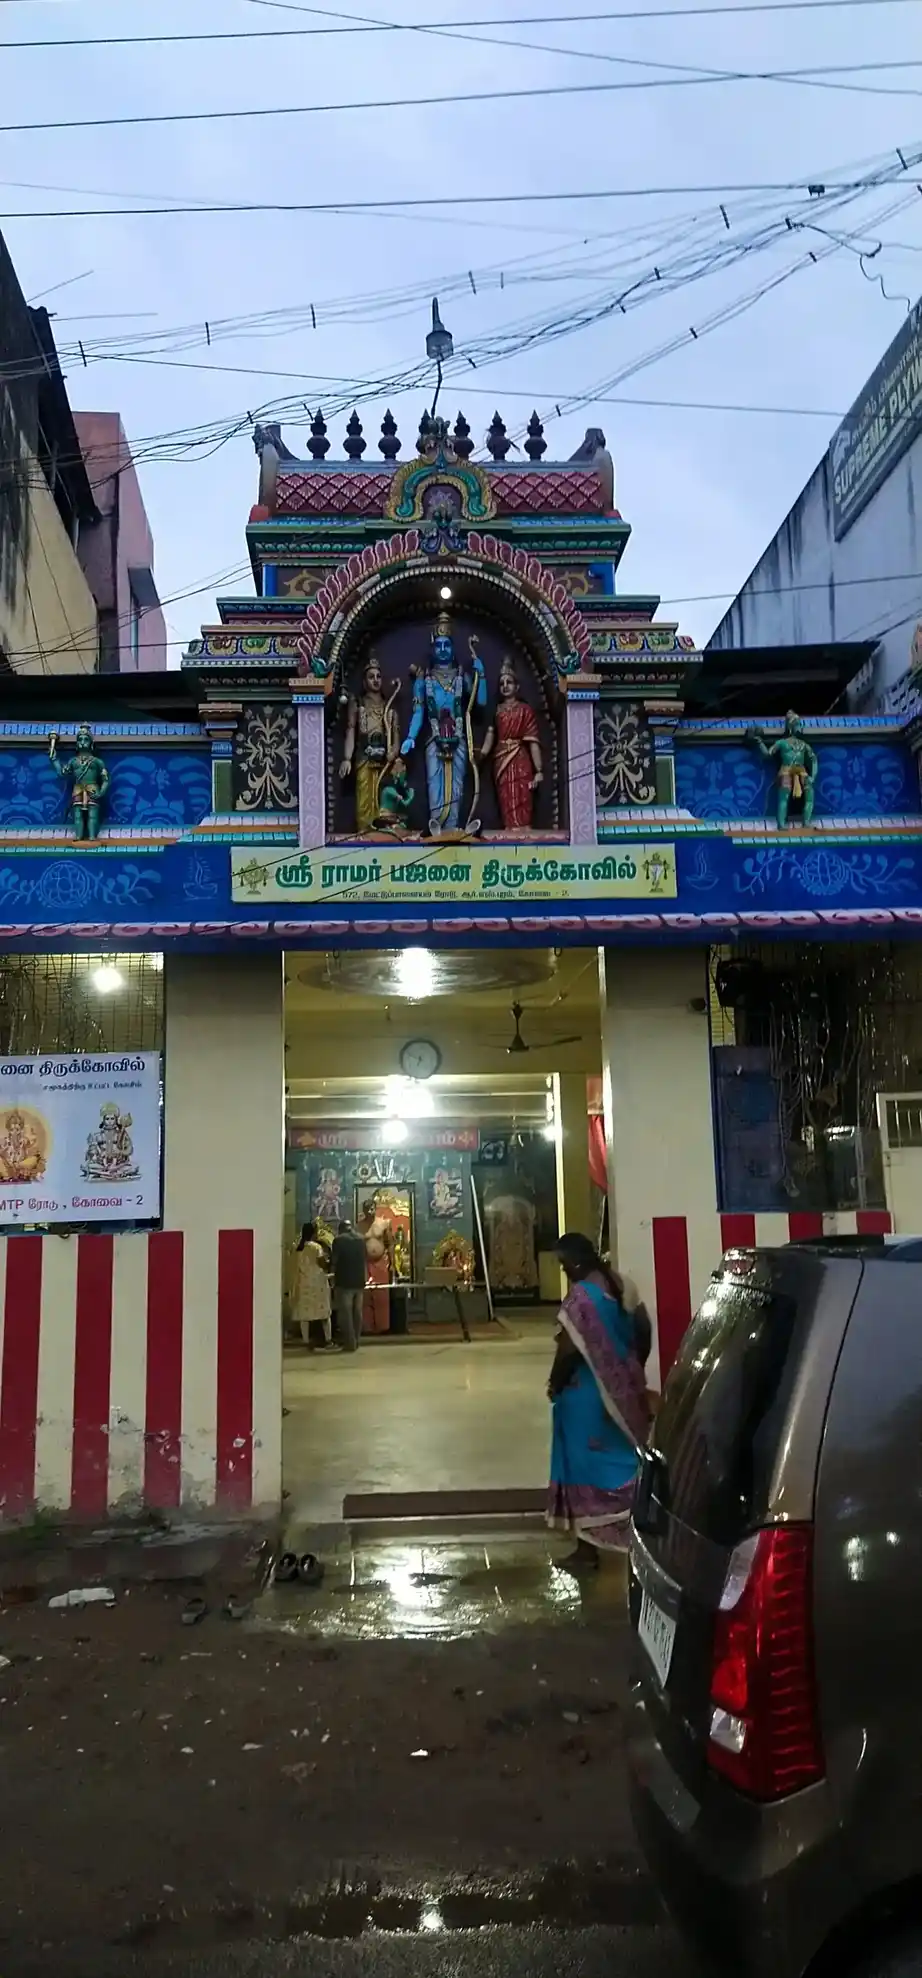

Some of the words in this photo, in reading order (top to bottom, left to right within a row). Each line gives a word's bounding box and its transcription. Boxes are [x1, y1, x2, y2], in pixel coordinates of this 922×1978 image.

[834, 405, 888, 505] SUPREME
[321, 858, 382, 888] ராமர்
[390, 863, 471, 883] பஜனை
[482, 854, 637, 888] திருக்கோவில்
[39, 1056, 145, 1077] திருக்கோவில்
[28, 1198, 59, 1211] ரோடு
[72, 1196, 122, 1209] கோவை
[136, 1195, 143, 1205] 2
